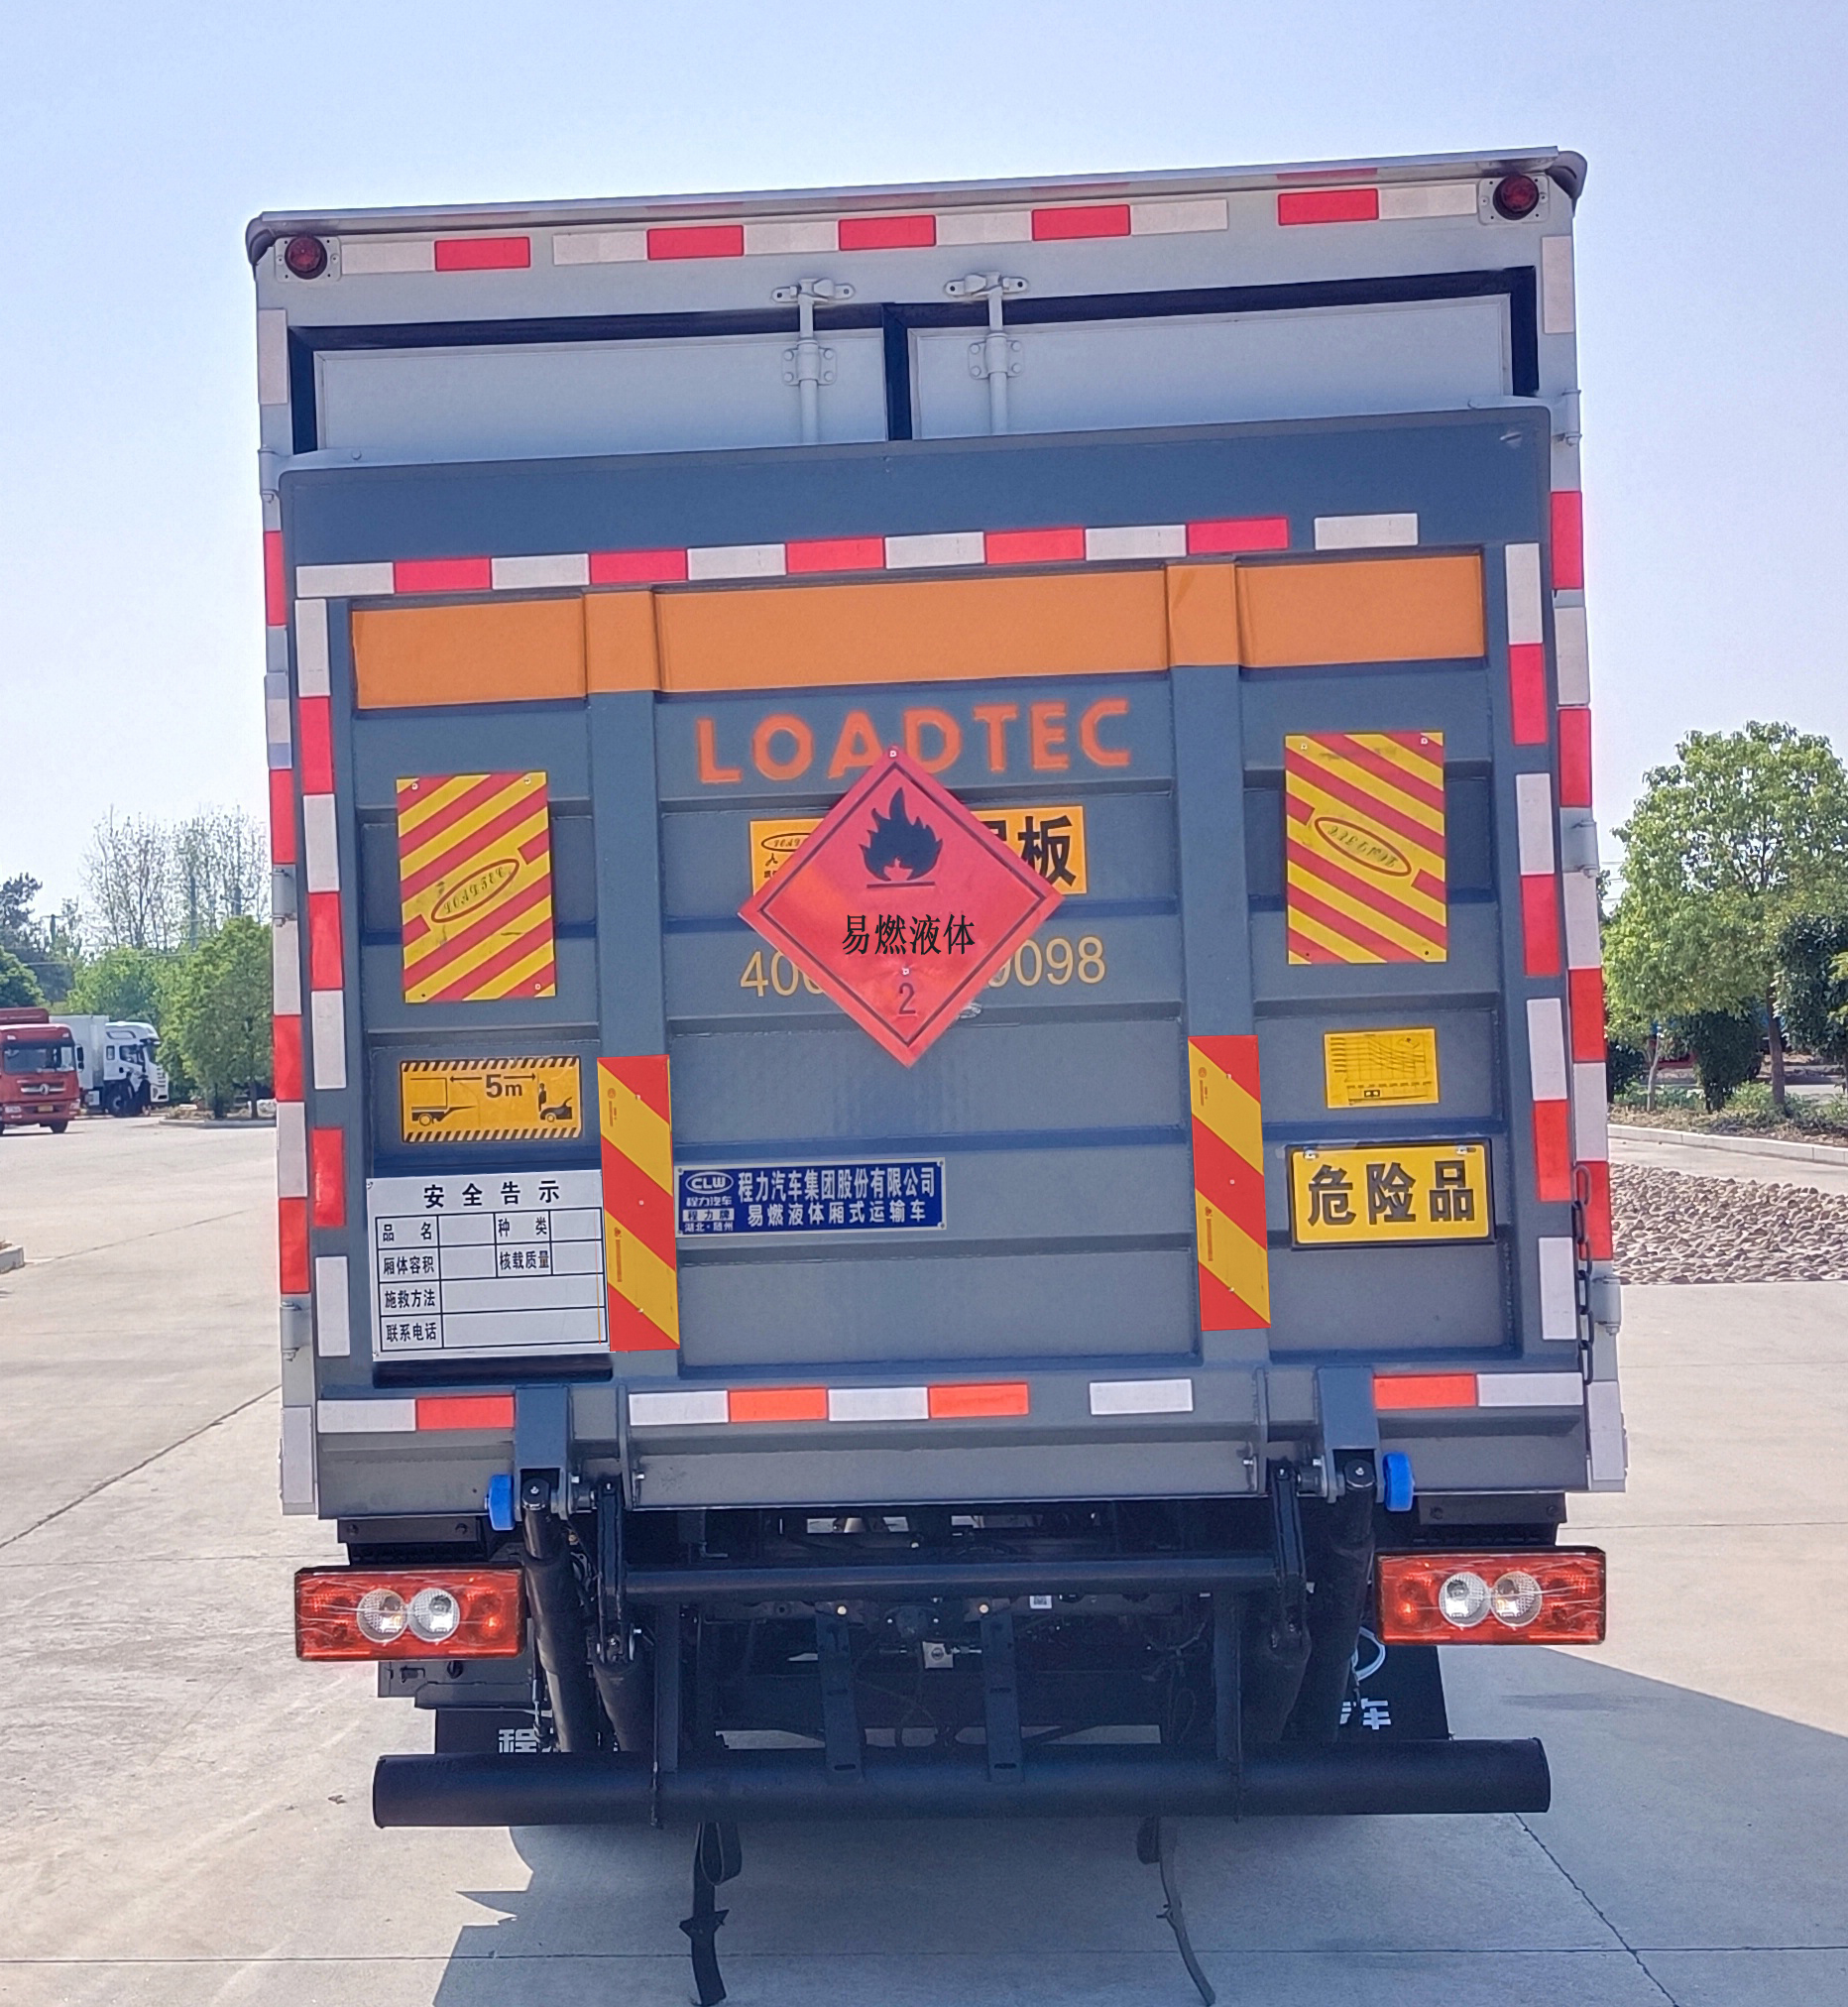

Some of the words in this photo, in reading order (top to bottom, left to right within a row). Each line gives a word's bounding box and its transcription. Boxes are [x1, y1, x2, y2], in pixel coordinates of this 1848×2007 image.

[697, 698, 1130, 783] LOADTEC
[842, 913, 976, 955] 易燃液体
[898, 982, 916, 1015] 2
[486, 1073, 522, 1099] 5m
[423, 1180, 560, 1209] 安全告示
[691, 1176, 726, 1189] CLW
[738, 1167, 935, 1203] 程力汽车集团股份有限公司
[1308, 1160, 1475, 1227] 危险品
[686, 1196, 733, 1207] 程力汽车
[748, 1199, 926, 1227] 易燃液体厢式运输车
[687, 1210, 731, 1220] 程力牌
[383, 1255, 434, 1275] 厢体容积
[499, 1249, 550, 1271] 核载质量
[385, 1288, 436, 1309] 施救方法
[386, 1322, 437, 1343] 联系电话
[499, 1728, 558, 1753] 程
